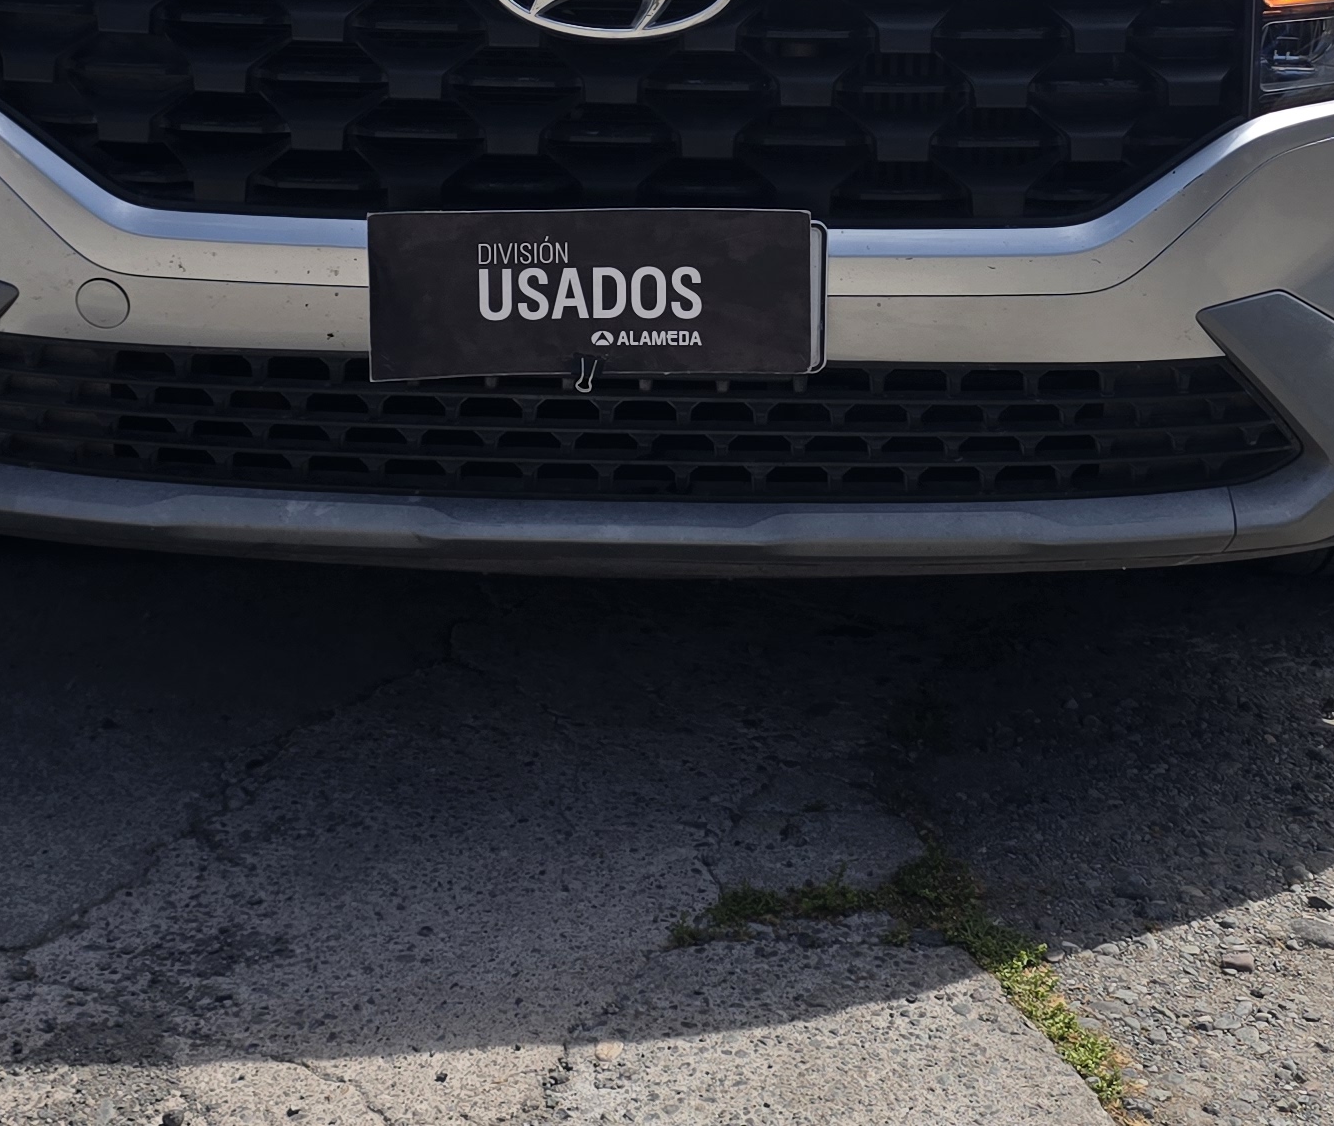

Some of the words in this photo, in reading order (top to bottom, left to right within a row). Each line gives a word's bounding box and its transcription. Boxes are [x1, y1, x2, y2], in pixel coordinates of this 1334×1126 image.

[478, 236, 569, 265] DIVISIÓN
[478, 266, 703, 321] USADOS
[617, 330, 702, 346] ALAMEDA
